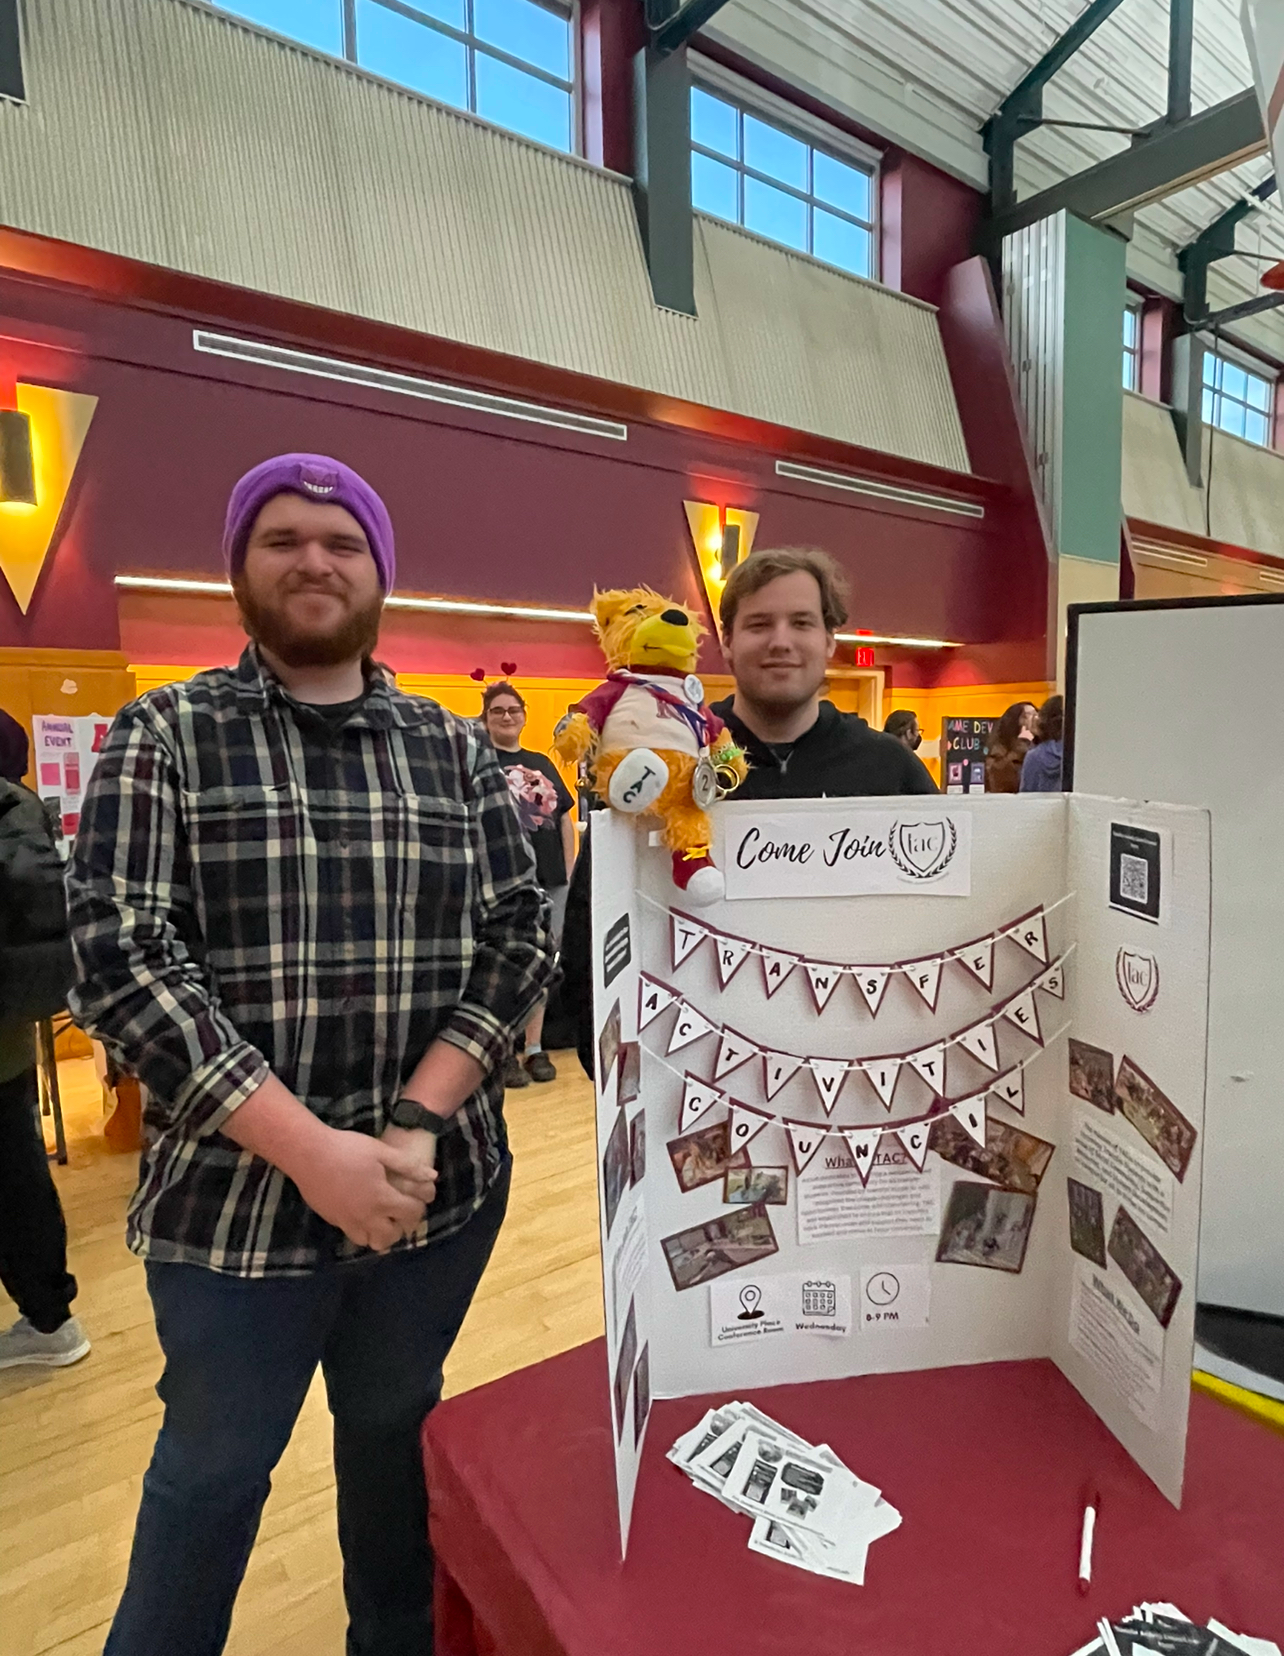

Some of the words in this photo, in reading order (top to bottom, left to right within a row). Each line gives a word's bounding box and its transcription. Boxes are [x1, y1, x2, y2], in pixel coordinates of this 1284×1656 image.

[948, 720, 969, 732] AME
[974, 721, 993, 733] DEV
[44, 735, 72, 747] EVENT
[953, 737, 980, 750] CLUB
[623, 765, 656, 804] TAC
[702, 774, 709, 791] 2
[736, 827, 816, 870] Come
[822, 827, 888, 867] Join
[678, 928, 1039, 996] TRANSFER
[645, 976, 1059, 1092] ACTIVITIES
[688, 1085, 1019, 1159] COUNCIL
[825, 1155, 854, 1169] Wha
[883, 1311, 899, 1320] PM
[721, 1322, 759, 1334] University
[795, 1321, 847, 1333] Wednesday
[717, 1329, 761, 1341] Conference
